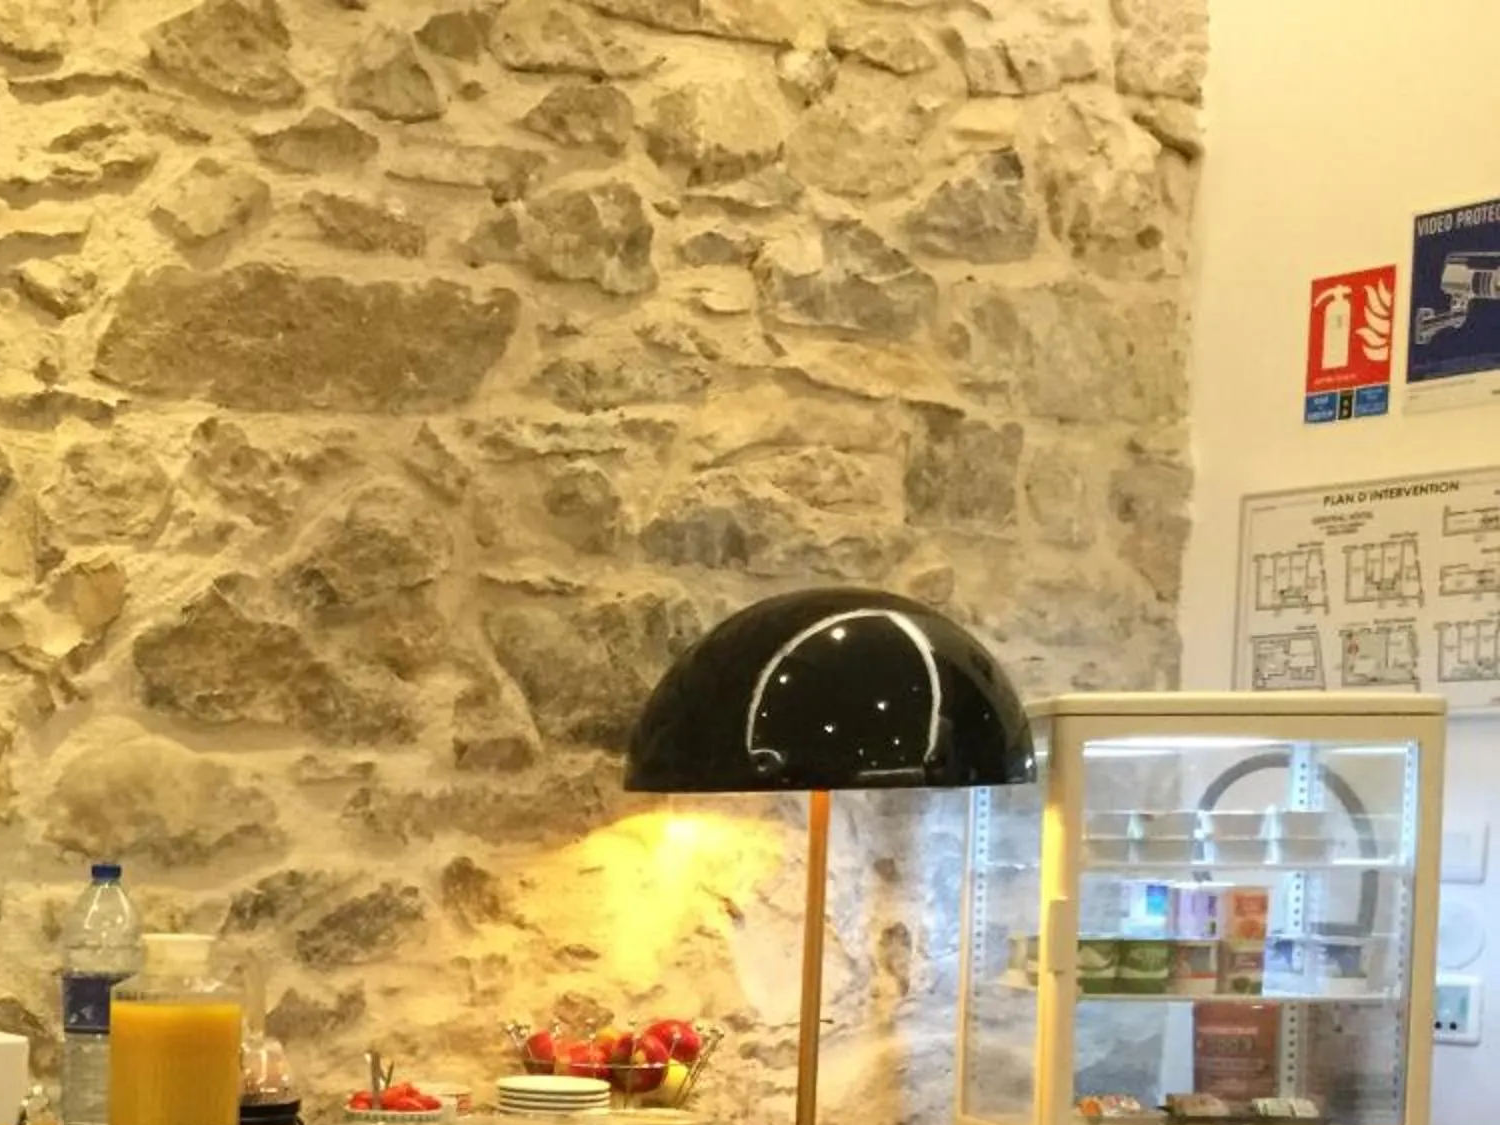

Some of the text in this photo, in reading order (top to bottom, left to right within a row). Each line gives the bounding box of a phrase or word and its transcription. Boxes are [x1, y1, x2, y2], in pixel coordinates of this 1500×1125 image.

[1417, 213, 1453, 236] VIDEO
[1323, 481, 1460, 507] PLAN DINTERVENTION
